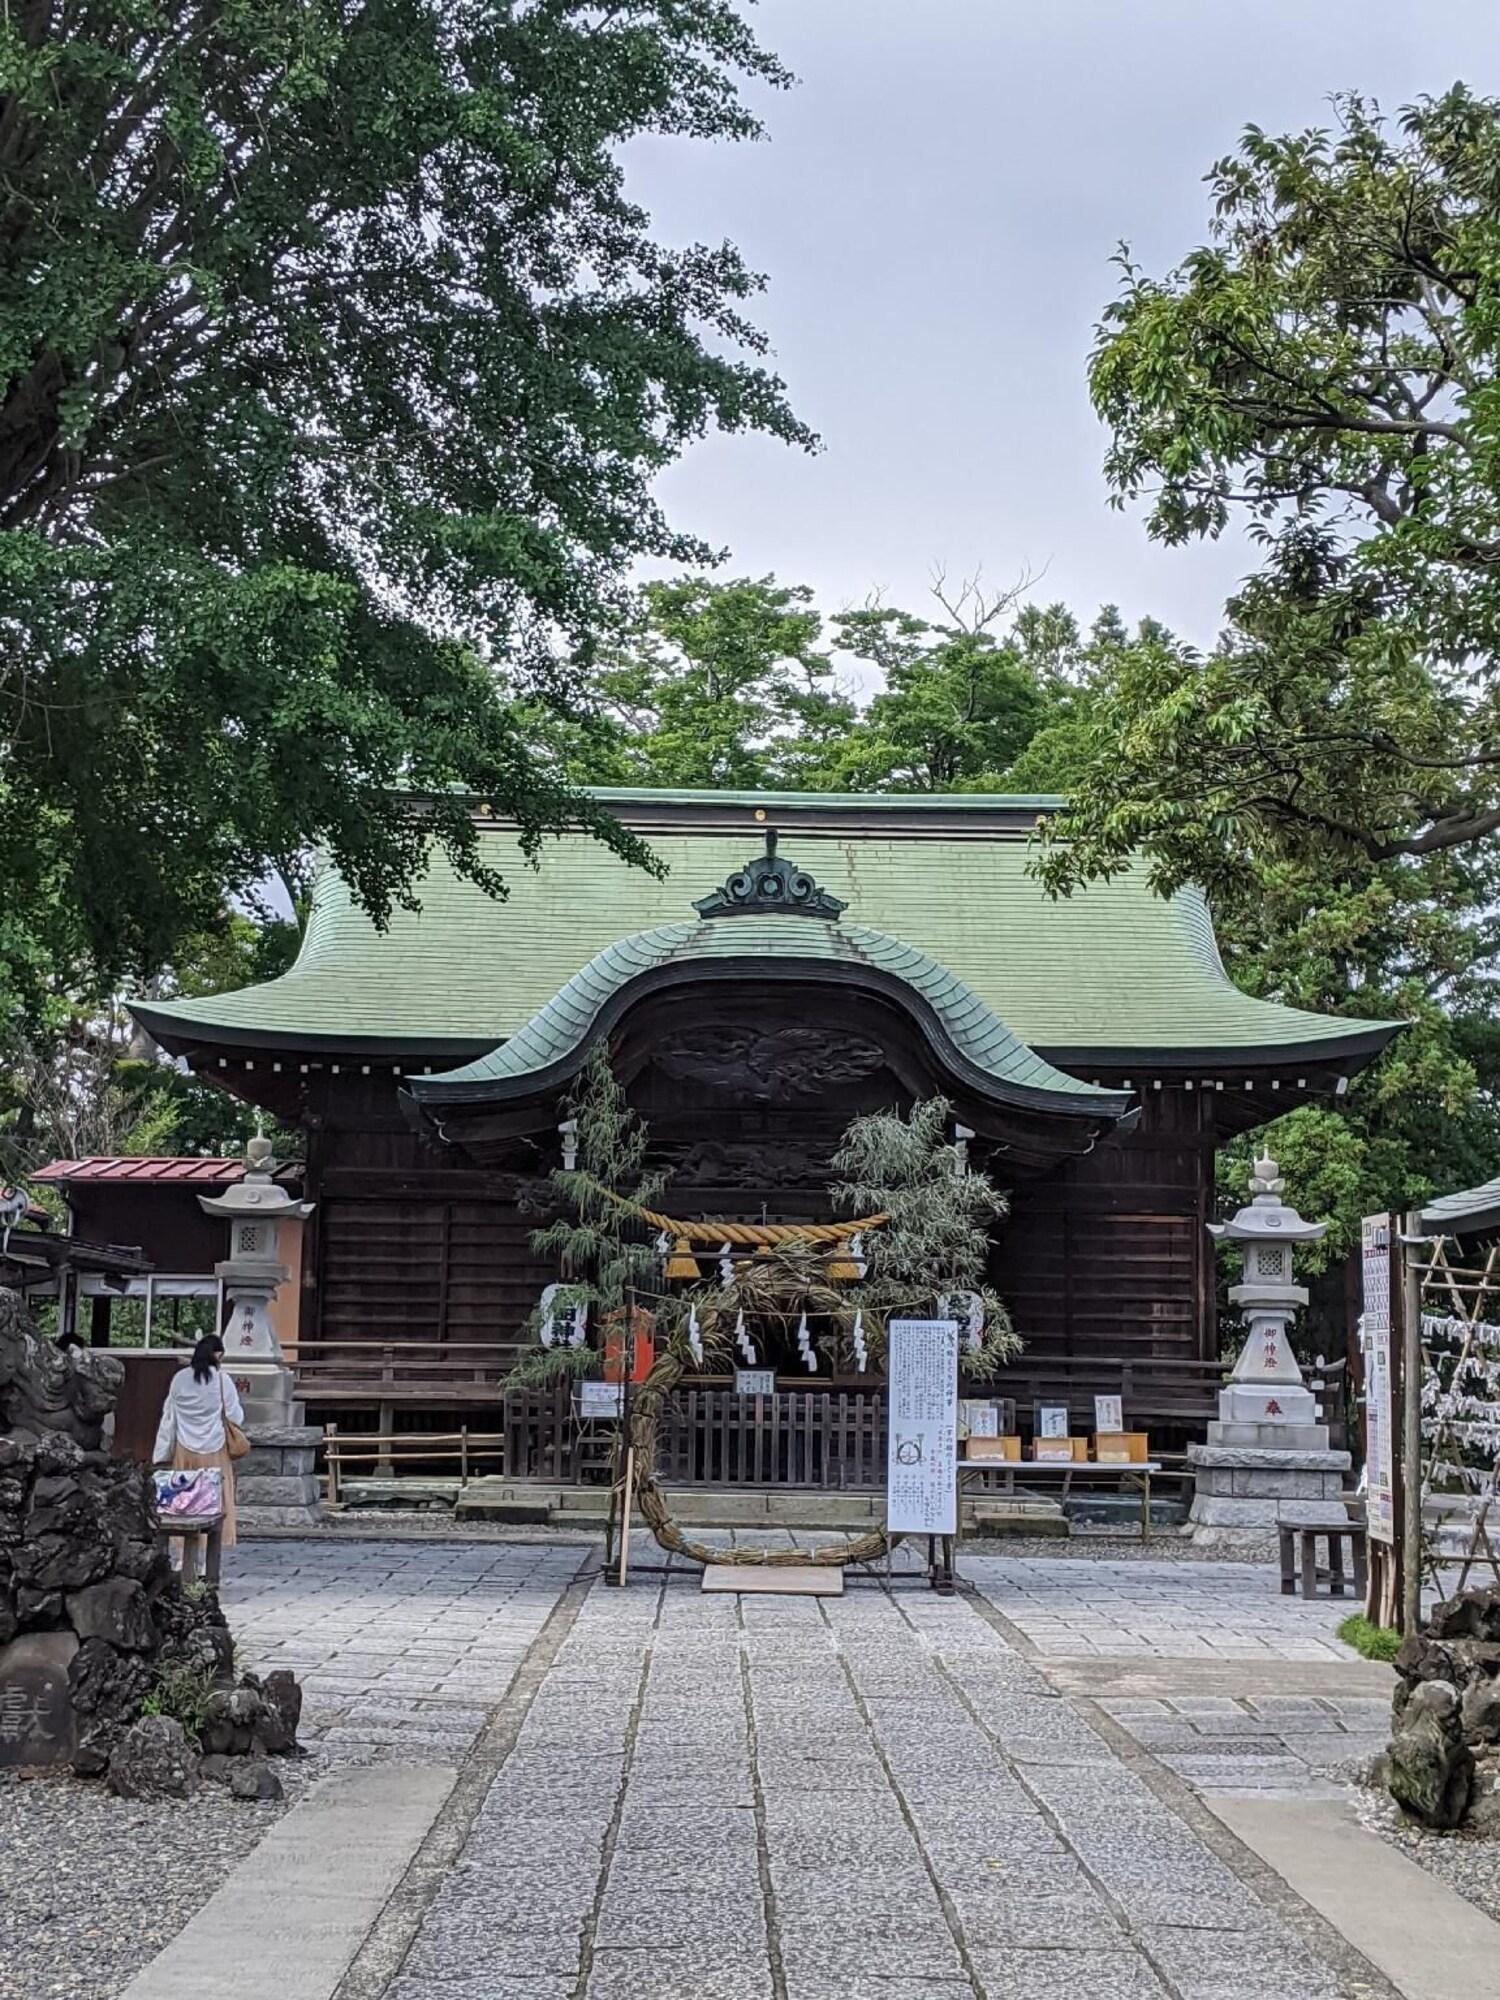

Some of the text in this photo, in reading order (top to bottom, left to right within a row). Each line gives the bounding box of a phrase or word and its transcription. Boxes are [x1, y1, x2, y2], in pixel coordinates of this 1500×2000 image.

[1263, 1327, 1277, 1368] 御神燈
[1265, 1399, 1283, 1416] 奉
